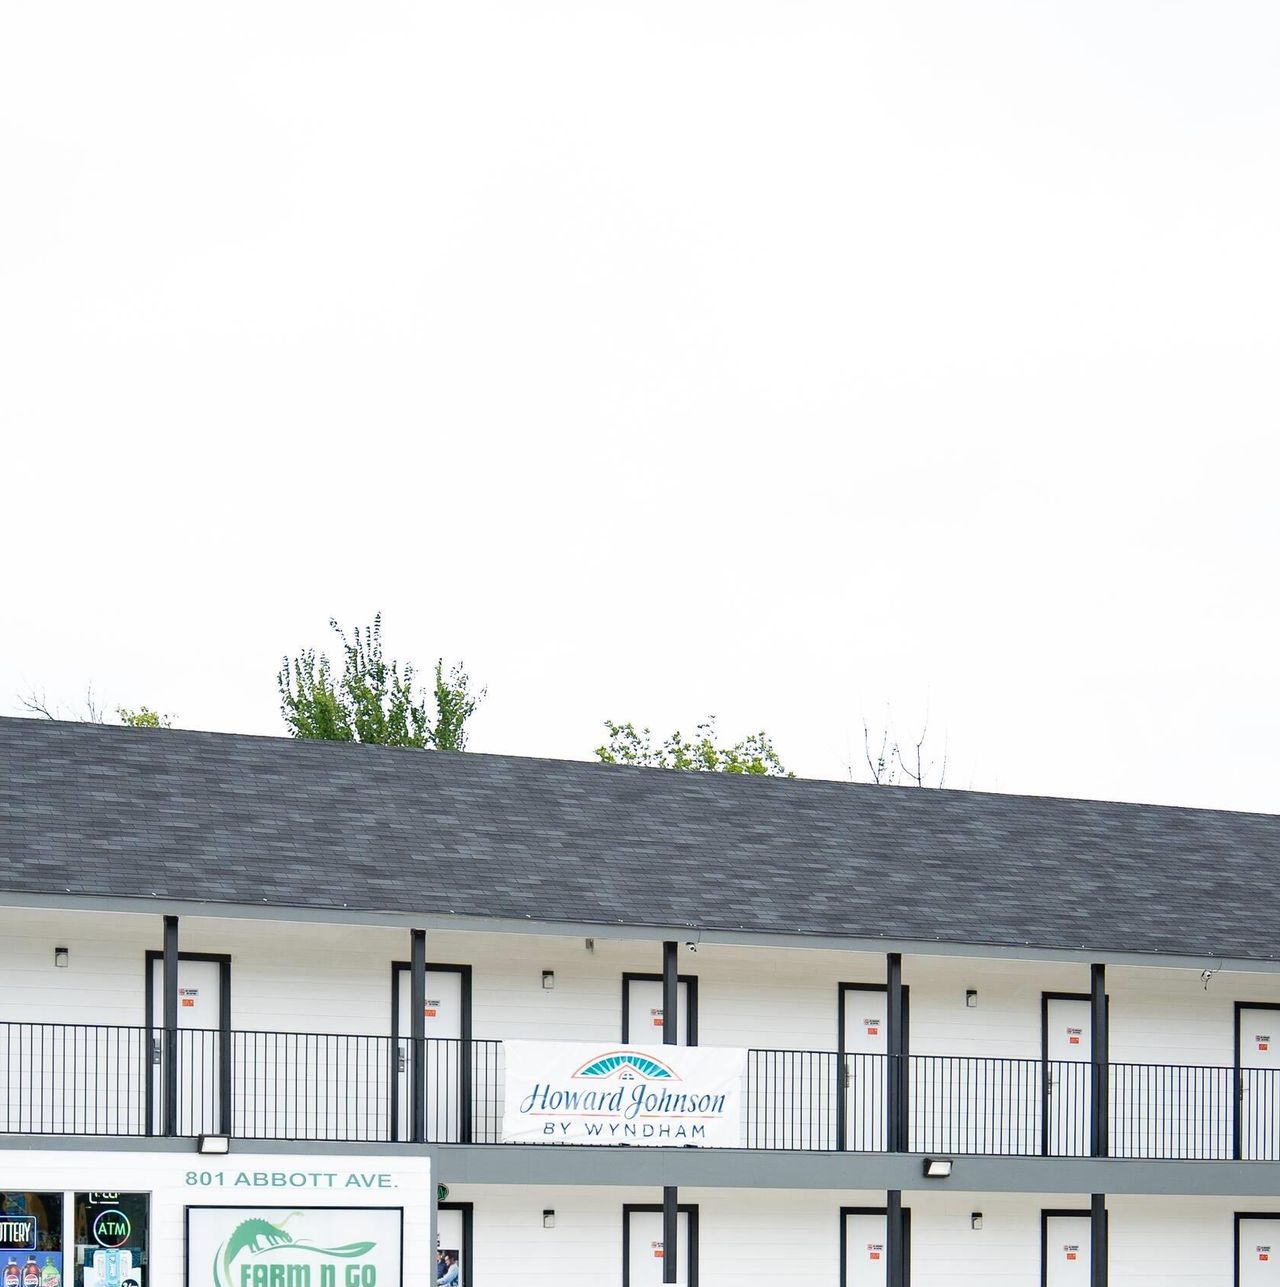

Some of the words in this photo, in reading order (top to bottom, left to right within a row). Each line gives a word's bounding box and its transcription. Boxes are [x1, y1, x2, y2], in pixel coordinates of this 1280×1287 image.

[520, 1084, 624, 1114] Howard
[624, 1084, 726, 1120] Johnson
[543, 1122, 571, 1135] BY
[585, 1123, 706, 1138] WYNDHAM
[185, 1171, 223, 1186] 801
[234, 1172, 337, 1187] ABBOTT
[345, 1174, 398, 1188] AVE.
[98, 1222, 126, 1235] ATM
